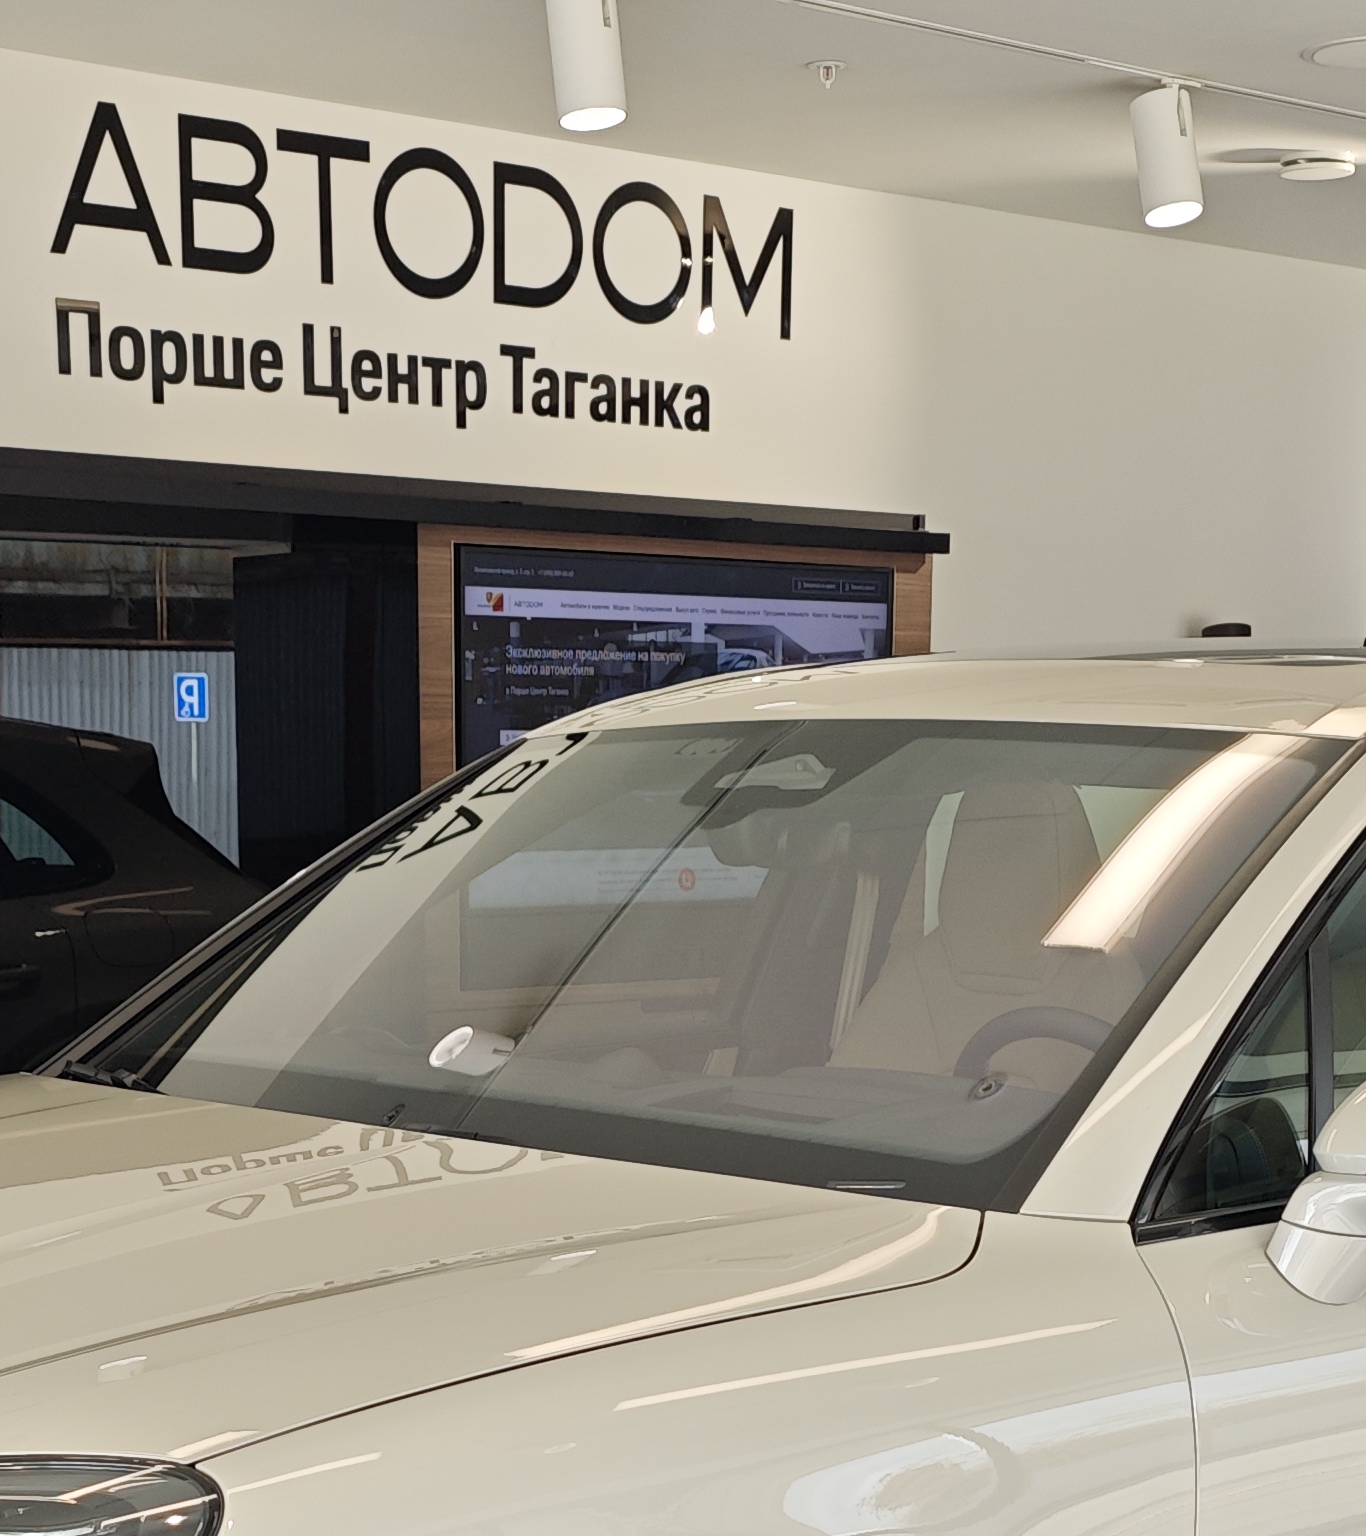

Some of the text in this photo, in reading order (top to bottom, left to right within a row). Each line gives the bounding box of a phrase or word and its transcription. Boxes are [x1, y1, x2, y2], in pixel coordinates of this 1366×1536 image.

[55, 297, 711, 432] Порше Центр Таганка
[575, 649, 636, 663] предложение
[637, 651, 648, 662] на
[505, 664, 538, 675] нового
